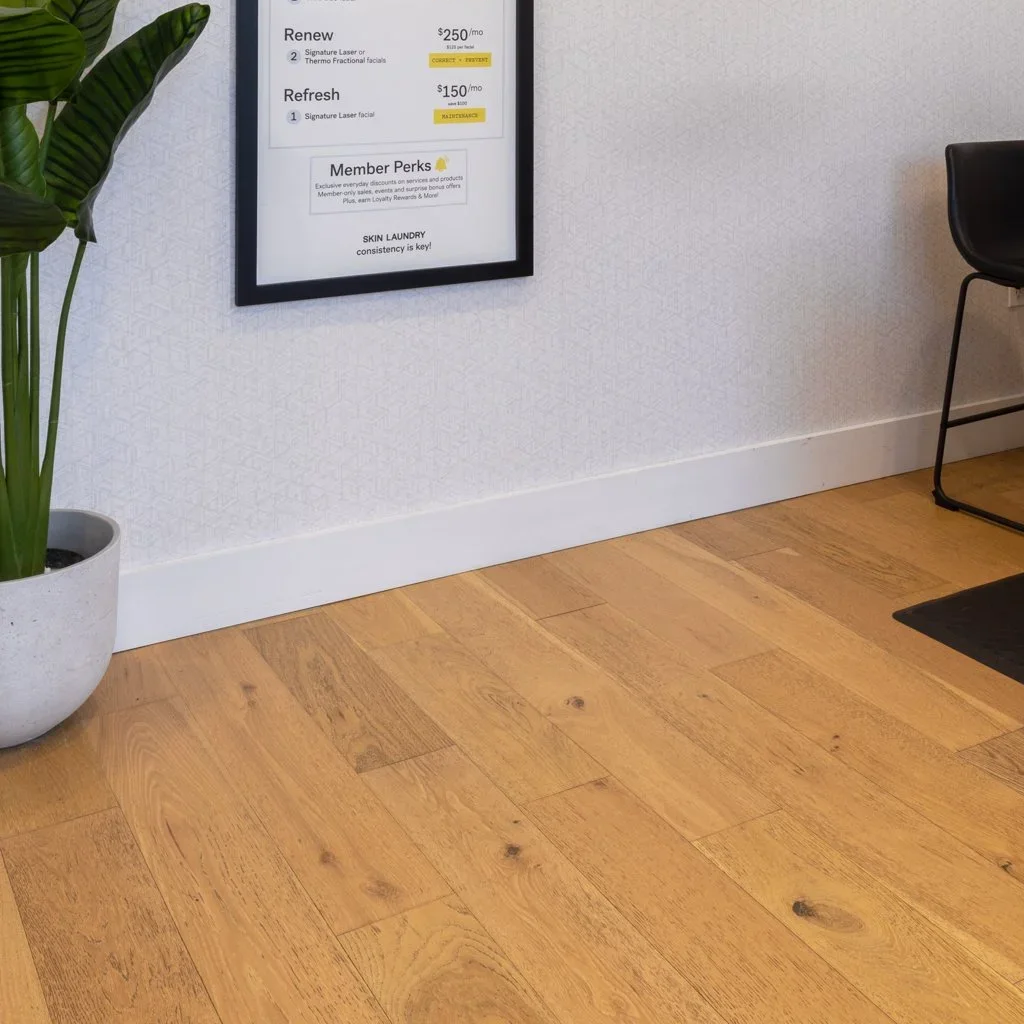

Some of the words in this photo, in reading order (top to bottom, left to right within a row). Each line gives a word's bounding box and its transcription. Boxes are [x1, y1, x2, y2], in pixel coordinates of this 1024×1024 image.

[284, 28, 333, 41] Renew
[438, 27, 483, 41] $250/mo
[304, 48, 337, 57] Signature
[284, 88, 339, 102] Refresh
[437, 84, 482, 98] $150/mo
[304, 112, 337, 121] Signature
[330, 162, 390, 176] Member
[394, 159, 431, 173] Perks
[363, 234, 383, 243] SKIN
[386, 231, 425, 241] LAUNDRY
[356, 246, 405, 255] consistency
[415, 241, 431, 251] key!
